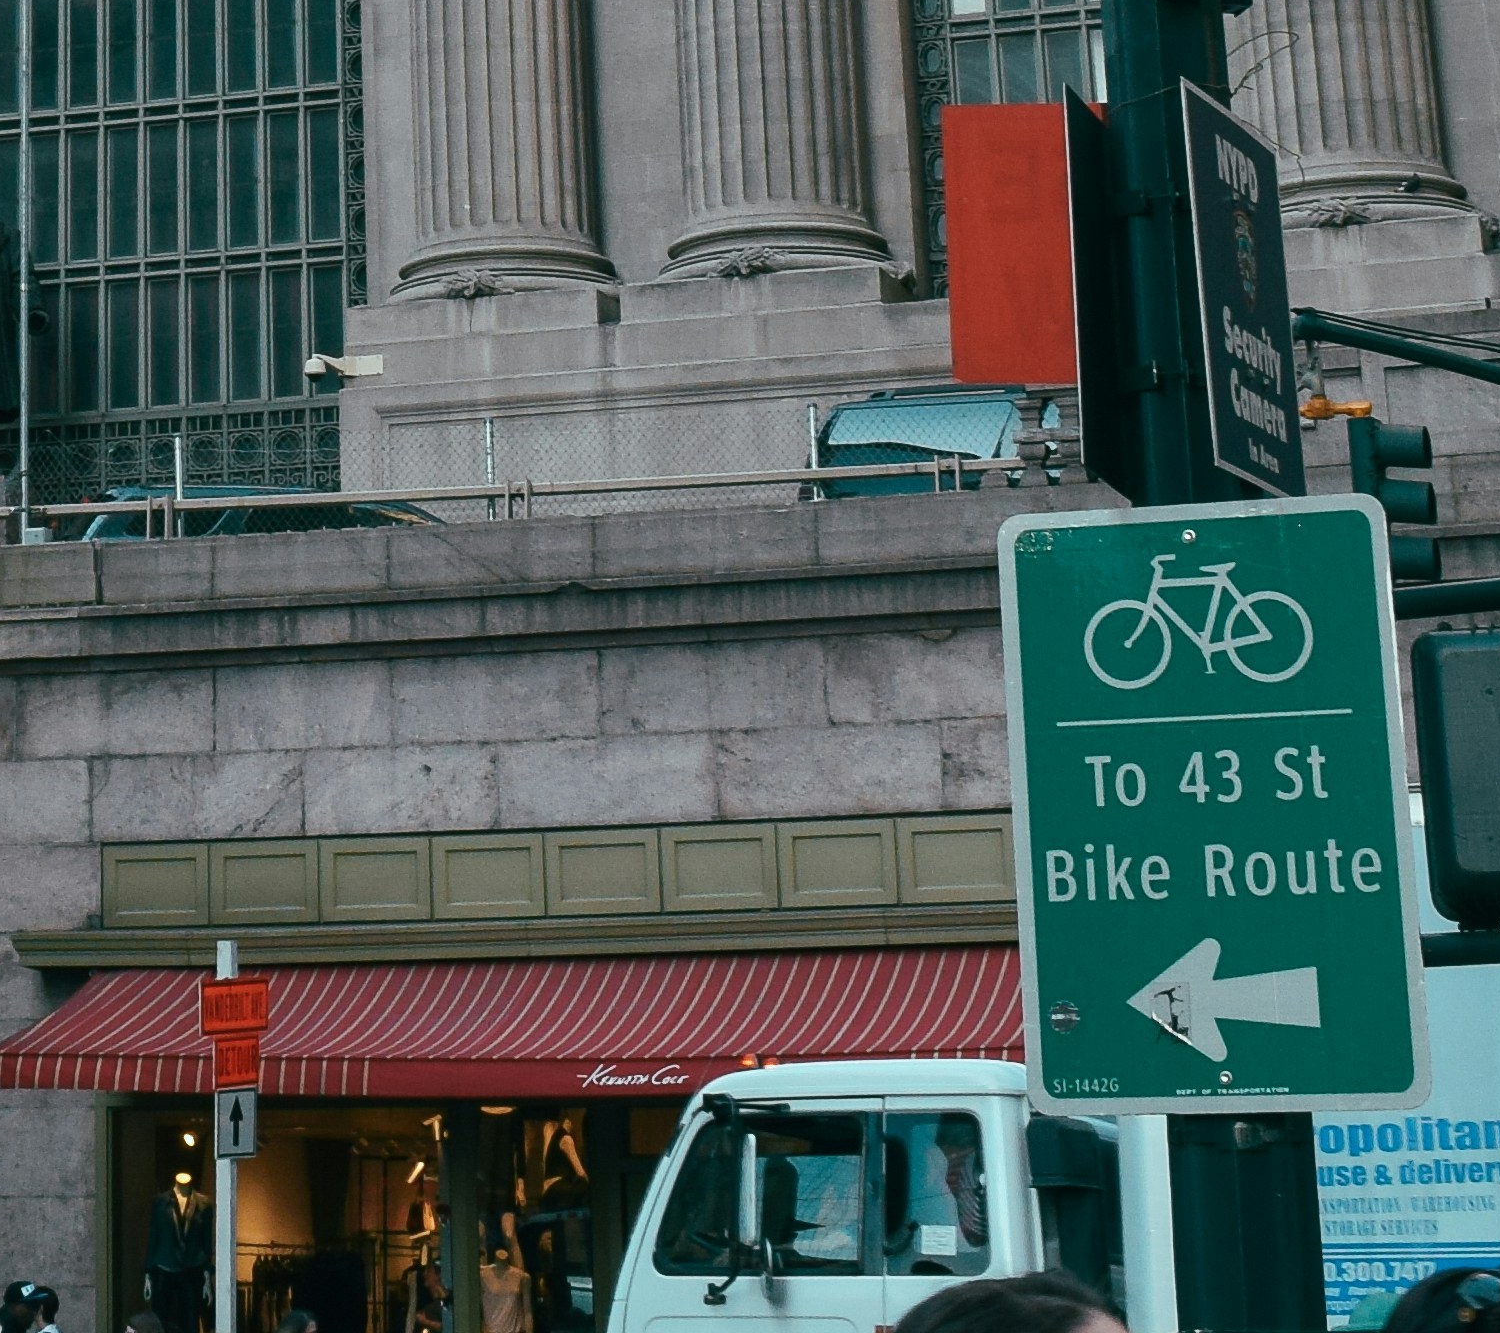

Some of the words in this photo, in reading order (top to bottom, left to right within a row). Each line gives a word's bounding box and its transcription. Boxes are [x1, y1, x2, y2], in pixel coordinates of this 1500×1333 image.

[1215, 134, 1260, 205] NYPD
[1223, 305, 1283, 395] Security
[1230, 367, 1288, 444] Camera
[1085, 755, 1147, 807] To
[1179, 749, 1244, 804] 43
[1274, 744, 1328, 801] St
[1045, 844, 1171, 903] Bike
[1205, 837, 1383, 898] Route
[1217, 1086, 1290, 1095] TRANSPORTATION
[1374, 1164, 1393, 1186] &
